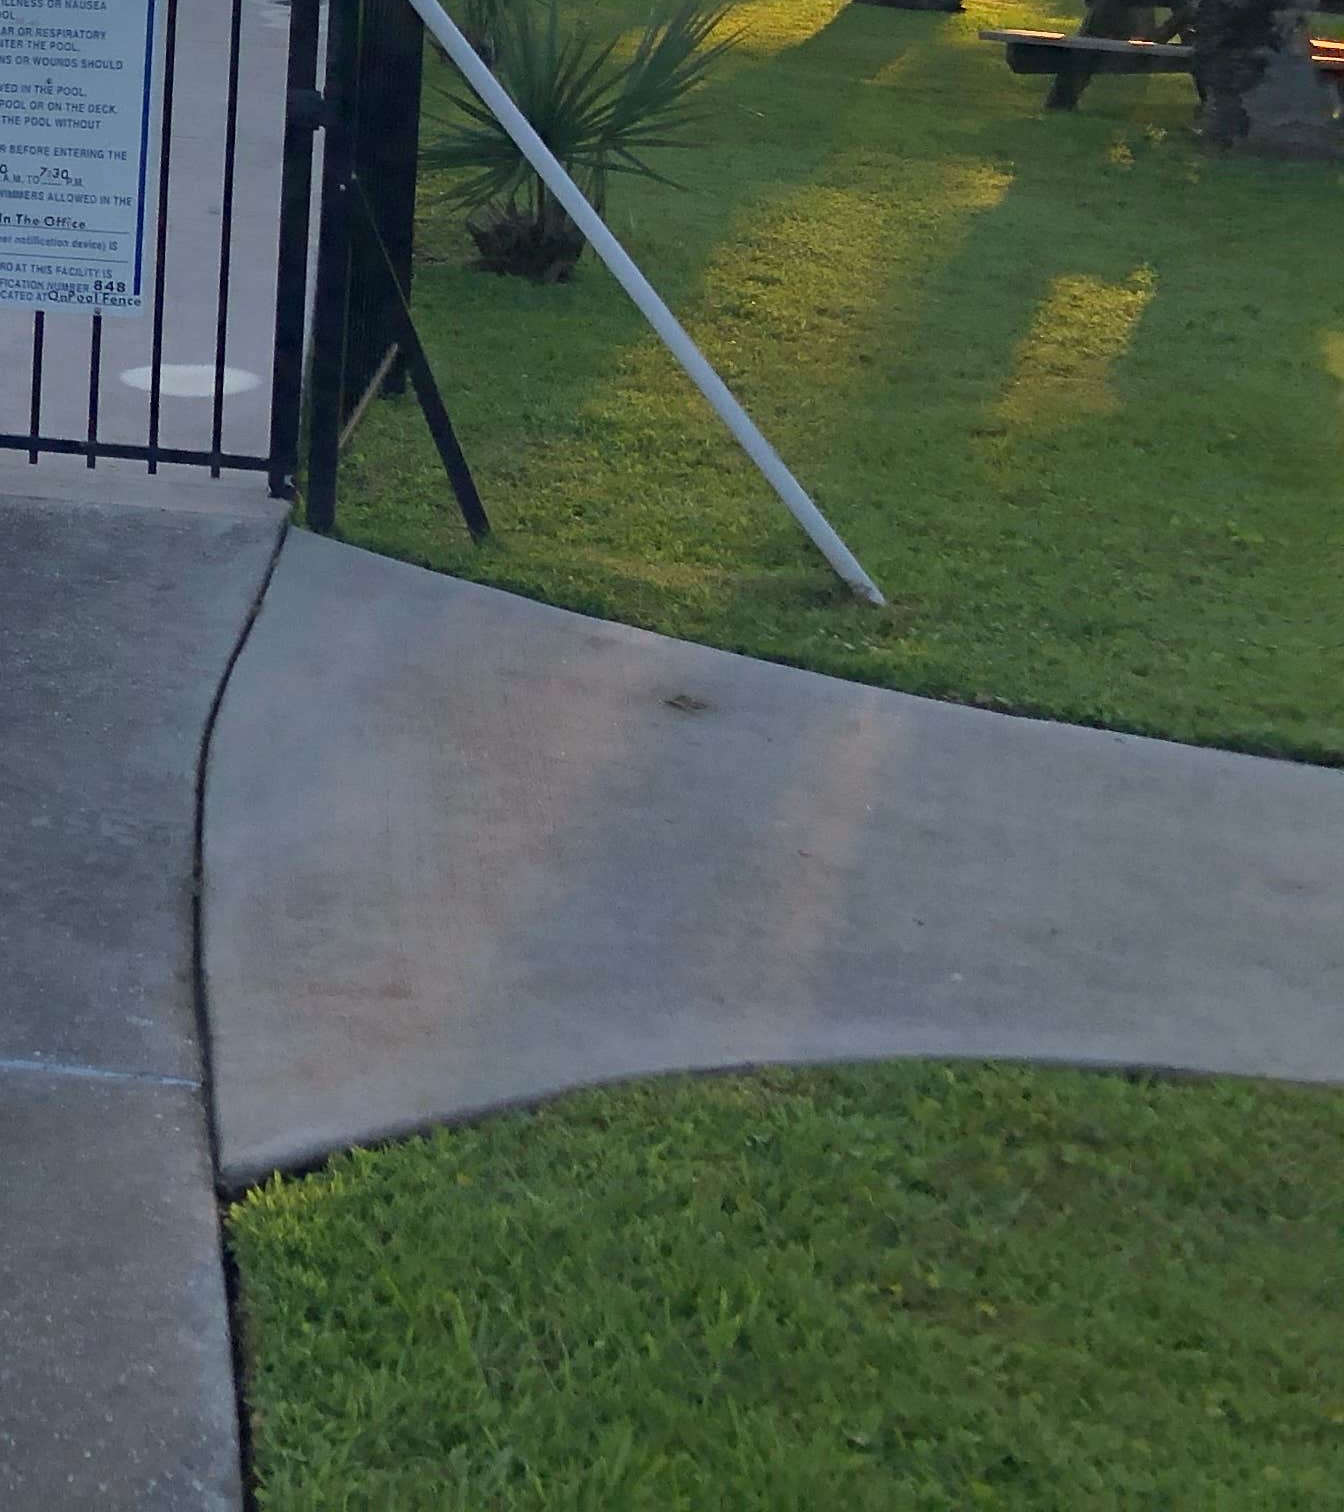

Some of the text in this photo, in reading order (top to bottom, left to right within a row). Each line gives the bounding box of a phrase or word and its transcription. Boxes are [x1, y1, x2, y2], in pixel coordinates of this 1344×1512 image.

[64, 0, 107, 10] NAUSEA
[26, 40, 46, 50] THE
[14, 55, 30, 65] OR
[32, 55, 78, 67] WOUNDS
[80, 58, 123, 70] SHOULD
[34, 84, 53, 95] THE
[29, 100, 44, 110] OR
[47, 101, 62, 111] ON
[64, 102, 84, 112] THE
[1, 114, 21, 125] THE
[23, 116, 52, 127] POOL
[54, 117, 101, 129] WITHOUT
[9, 144, 50, 156] BEFORE
[53, 146, 105, 159] ENTERING
[107, 149, 127, 160] THE
[38, 166, 69, 179] 7:30
[15, 213, 40, 226] The
[43, 215, 86, 229] Office
[93, 279, 126, 293] 848
